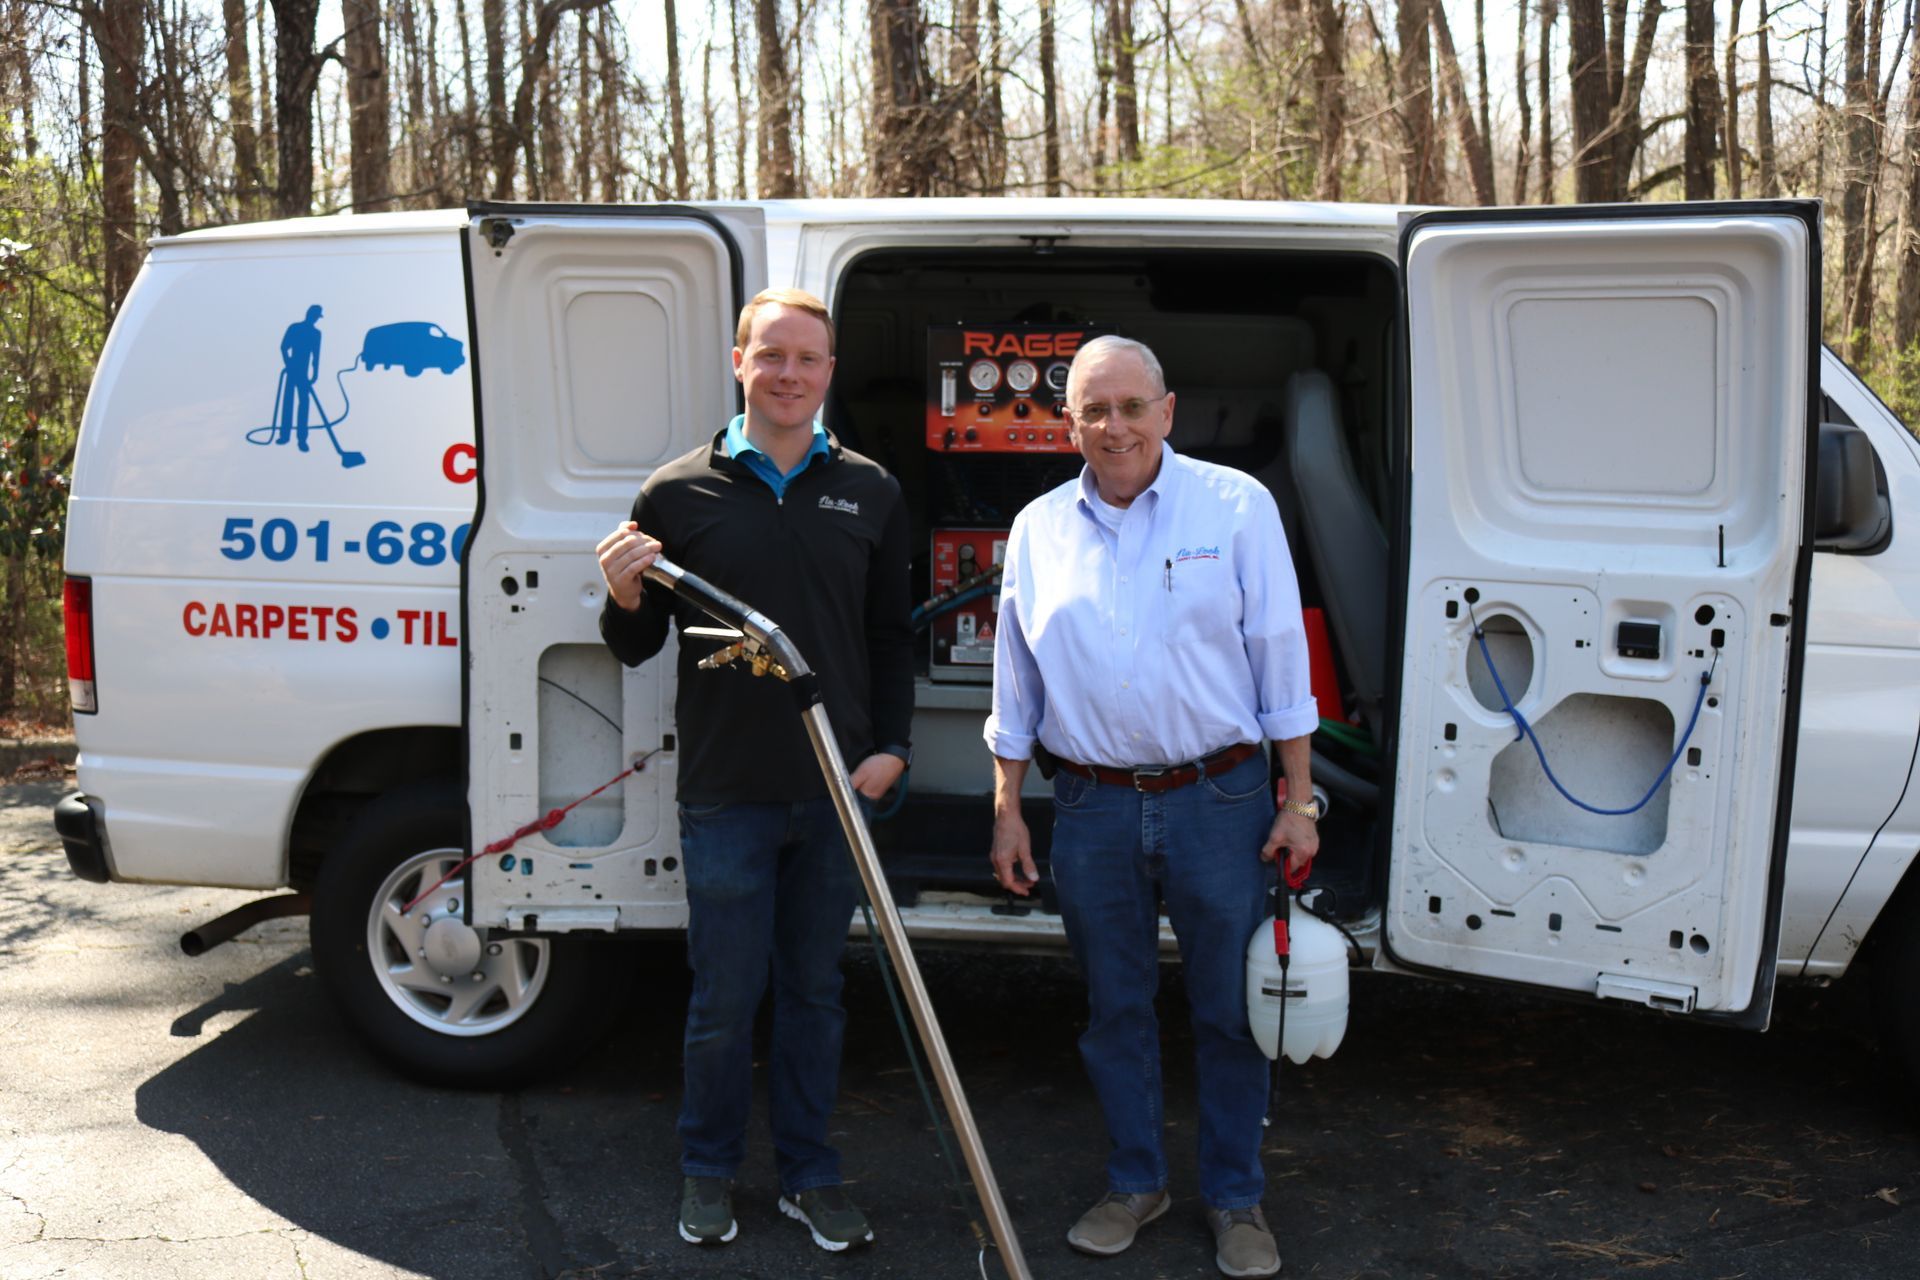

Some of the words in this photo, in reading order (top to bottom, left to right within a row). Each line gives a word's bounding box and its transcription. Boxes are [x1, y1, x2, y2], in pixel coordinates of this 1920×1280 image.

[963, 331, 1083, 357] RAGE
[442, 443, 477, 484] C
[183, 601, 359, 643] CARPETS
[397, 610, 458, 647] TIL
